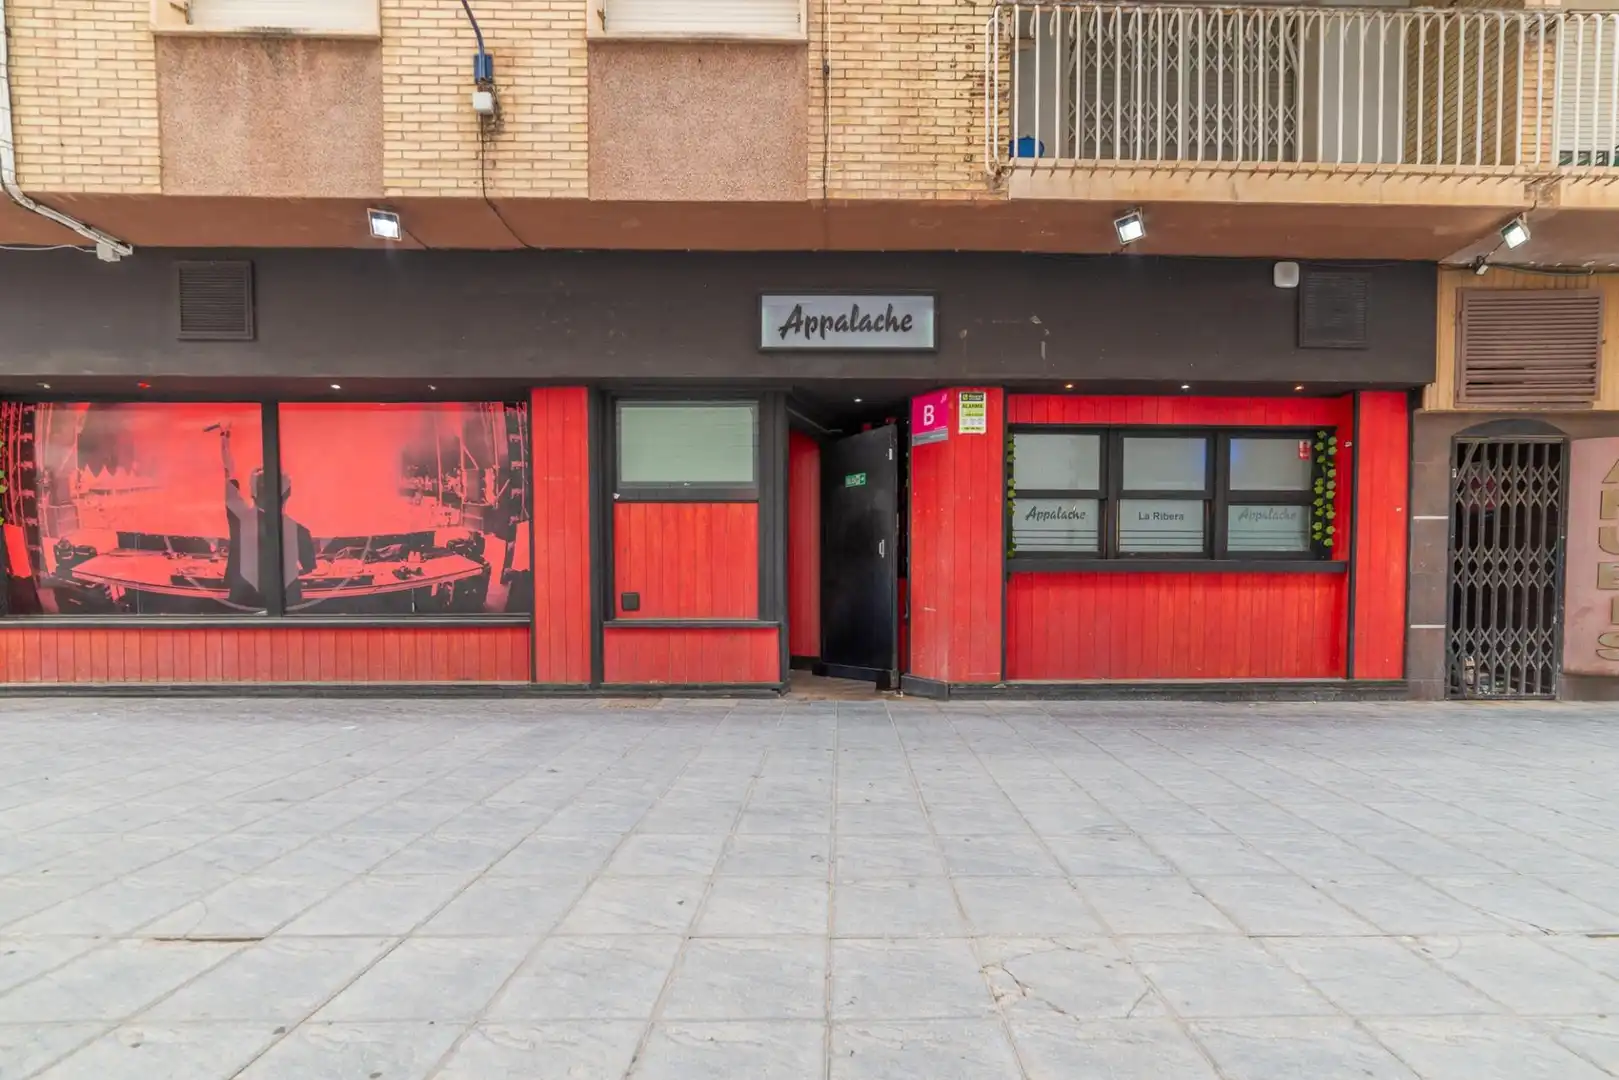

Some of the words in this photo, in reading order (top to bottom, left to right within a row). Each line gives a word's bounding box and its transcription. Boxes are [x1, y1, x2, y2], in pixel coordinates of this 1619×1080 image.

[778, 303, 913, 340] Appalache
[923, 404, 935, 427] B
[1025, 505, 1086, 522] Appalache
[1138, 511, 1149, 521] La
[1153, 511, 1184, 521] Ribera
